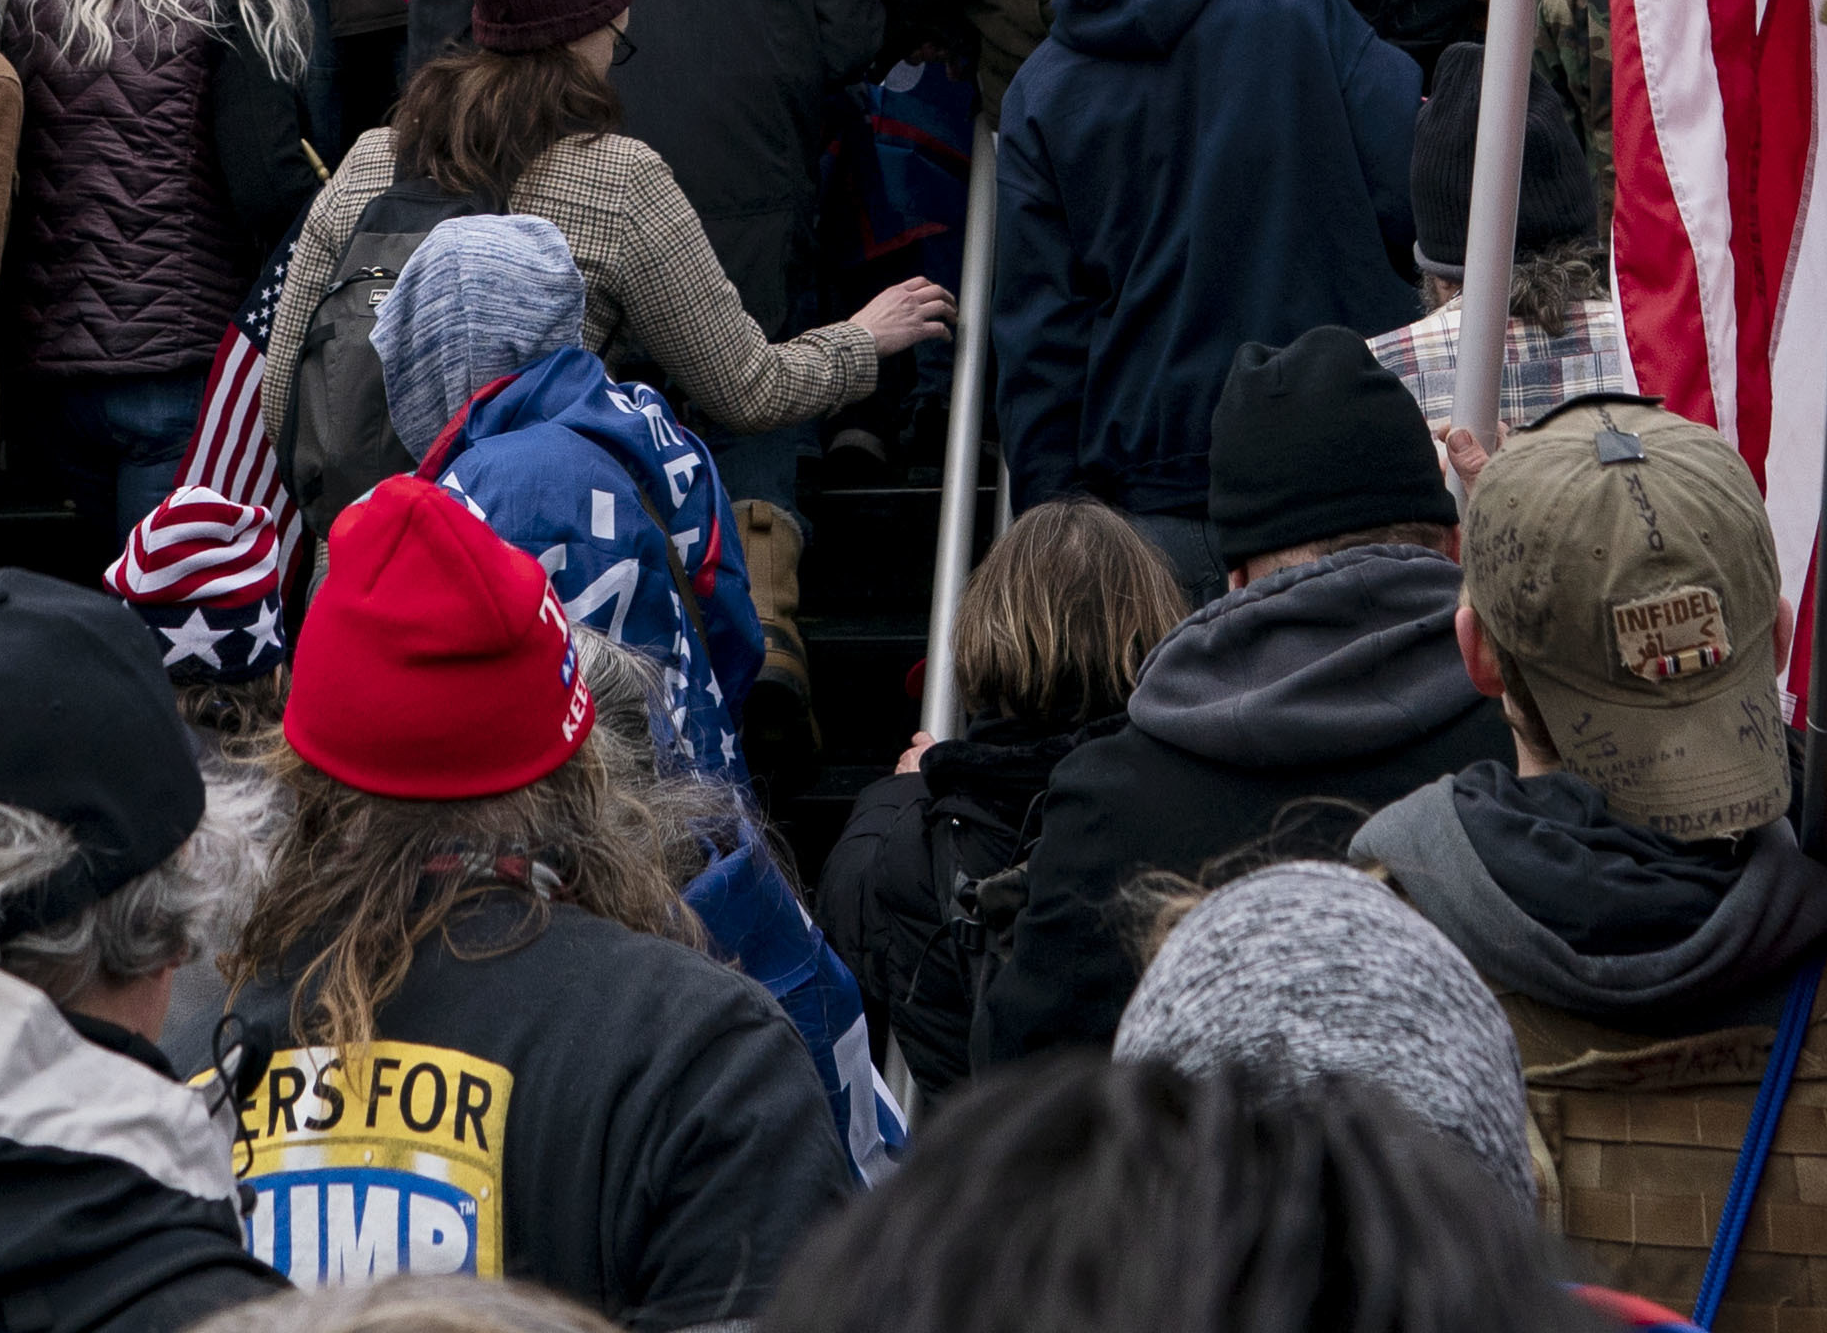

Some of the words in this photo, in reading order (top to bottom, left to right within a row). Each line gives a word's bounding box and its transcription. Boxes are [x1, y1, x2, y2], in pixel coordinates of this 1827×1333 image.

[1615, 592, 1719, 634] INFIDEL
[365, 1057, 490, 1153] FOR
[251, 1183, 469, 1289] UMP
